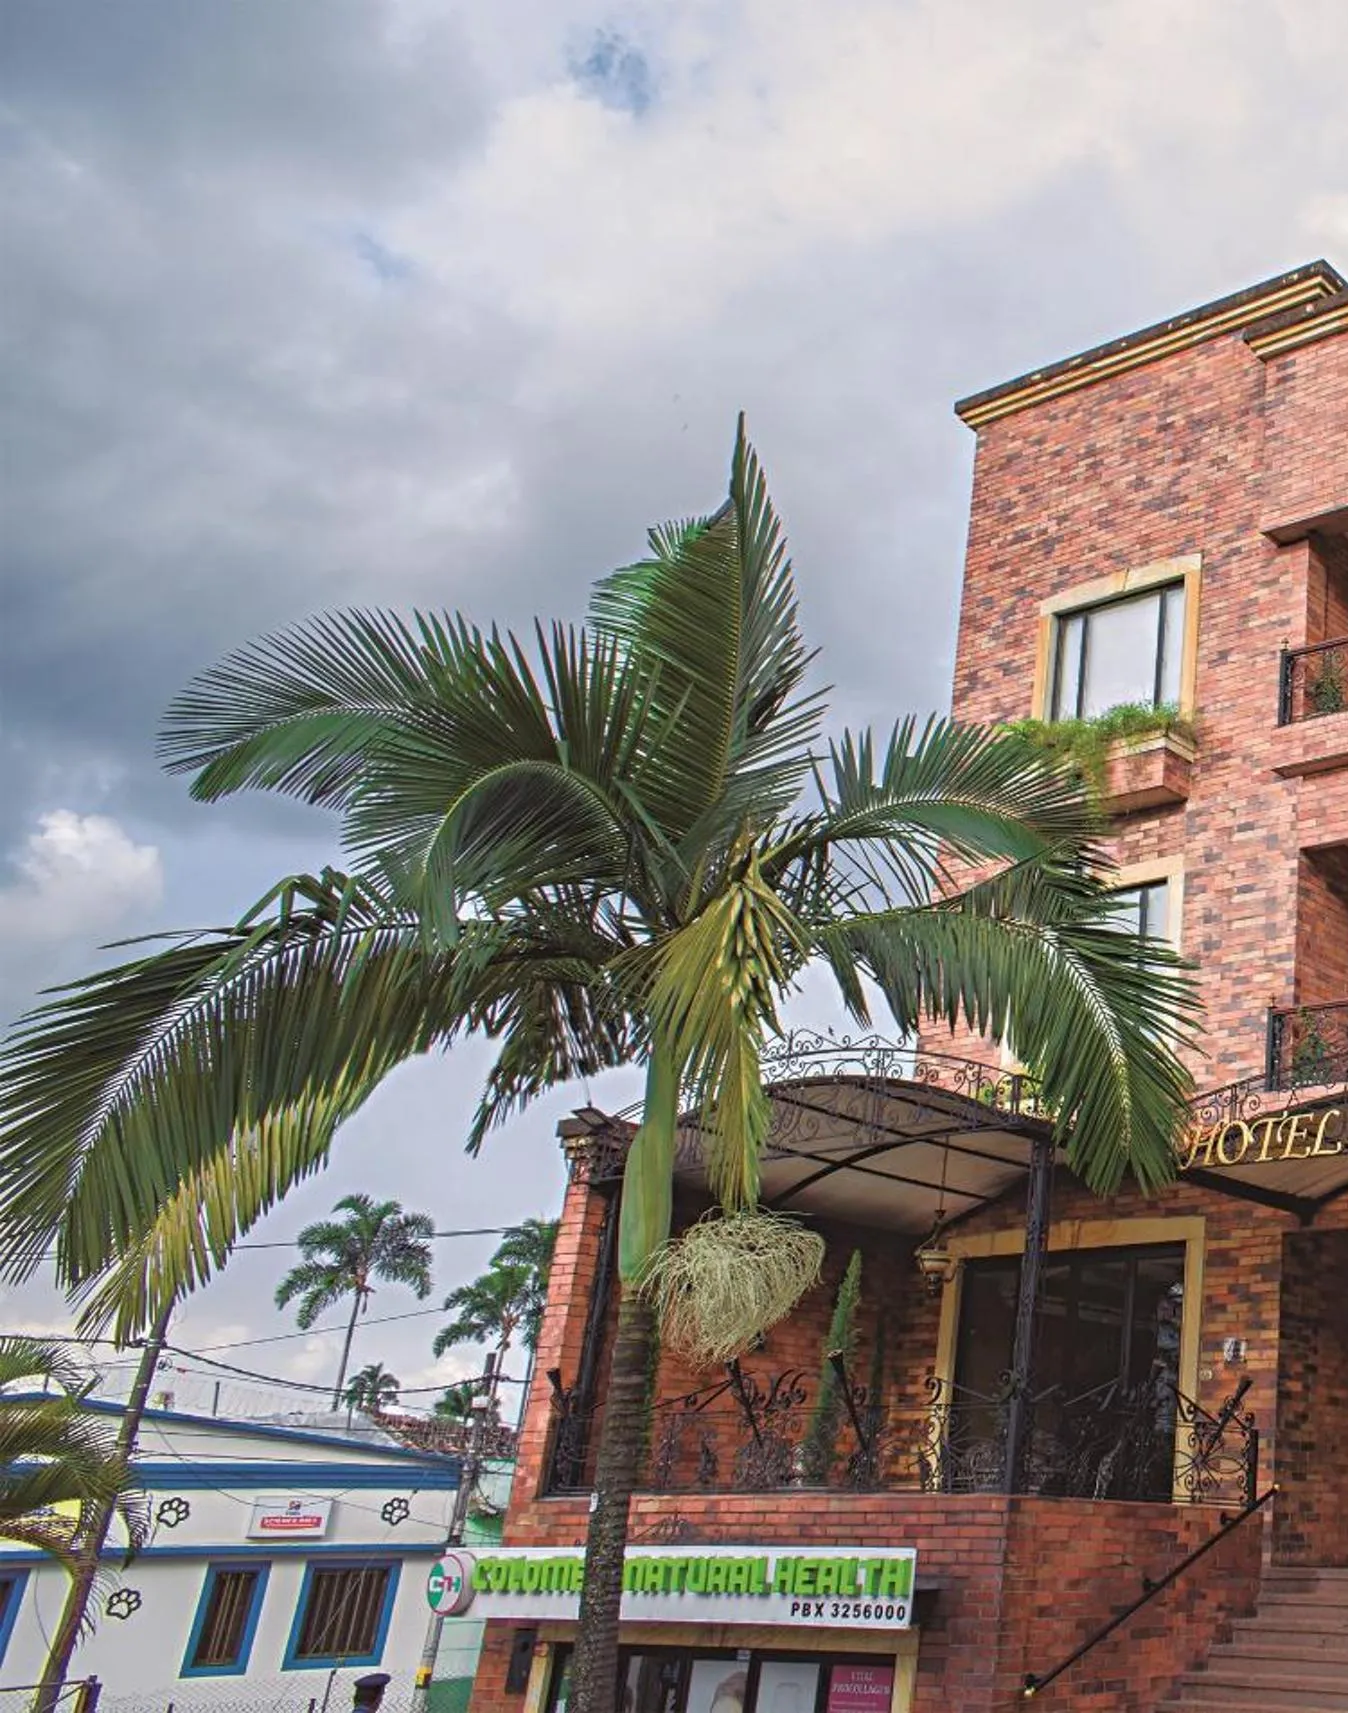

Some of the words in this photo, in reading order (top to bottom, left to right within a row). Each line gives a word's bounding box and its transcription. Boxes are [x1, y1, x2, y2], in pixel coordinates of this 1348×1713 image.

[1178, 1108, 1343, 1170] HOTEL
[622, 1557, 770, 1594] NATURAL
[772, 1557, 914, 1598] HEALTH
[790, 1602, 825, 1618] PBX
[831, 1603, 907, 1622] 3256000
